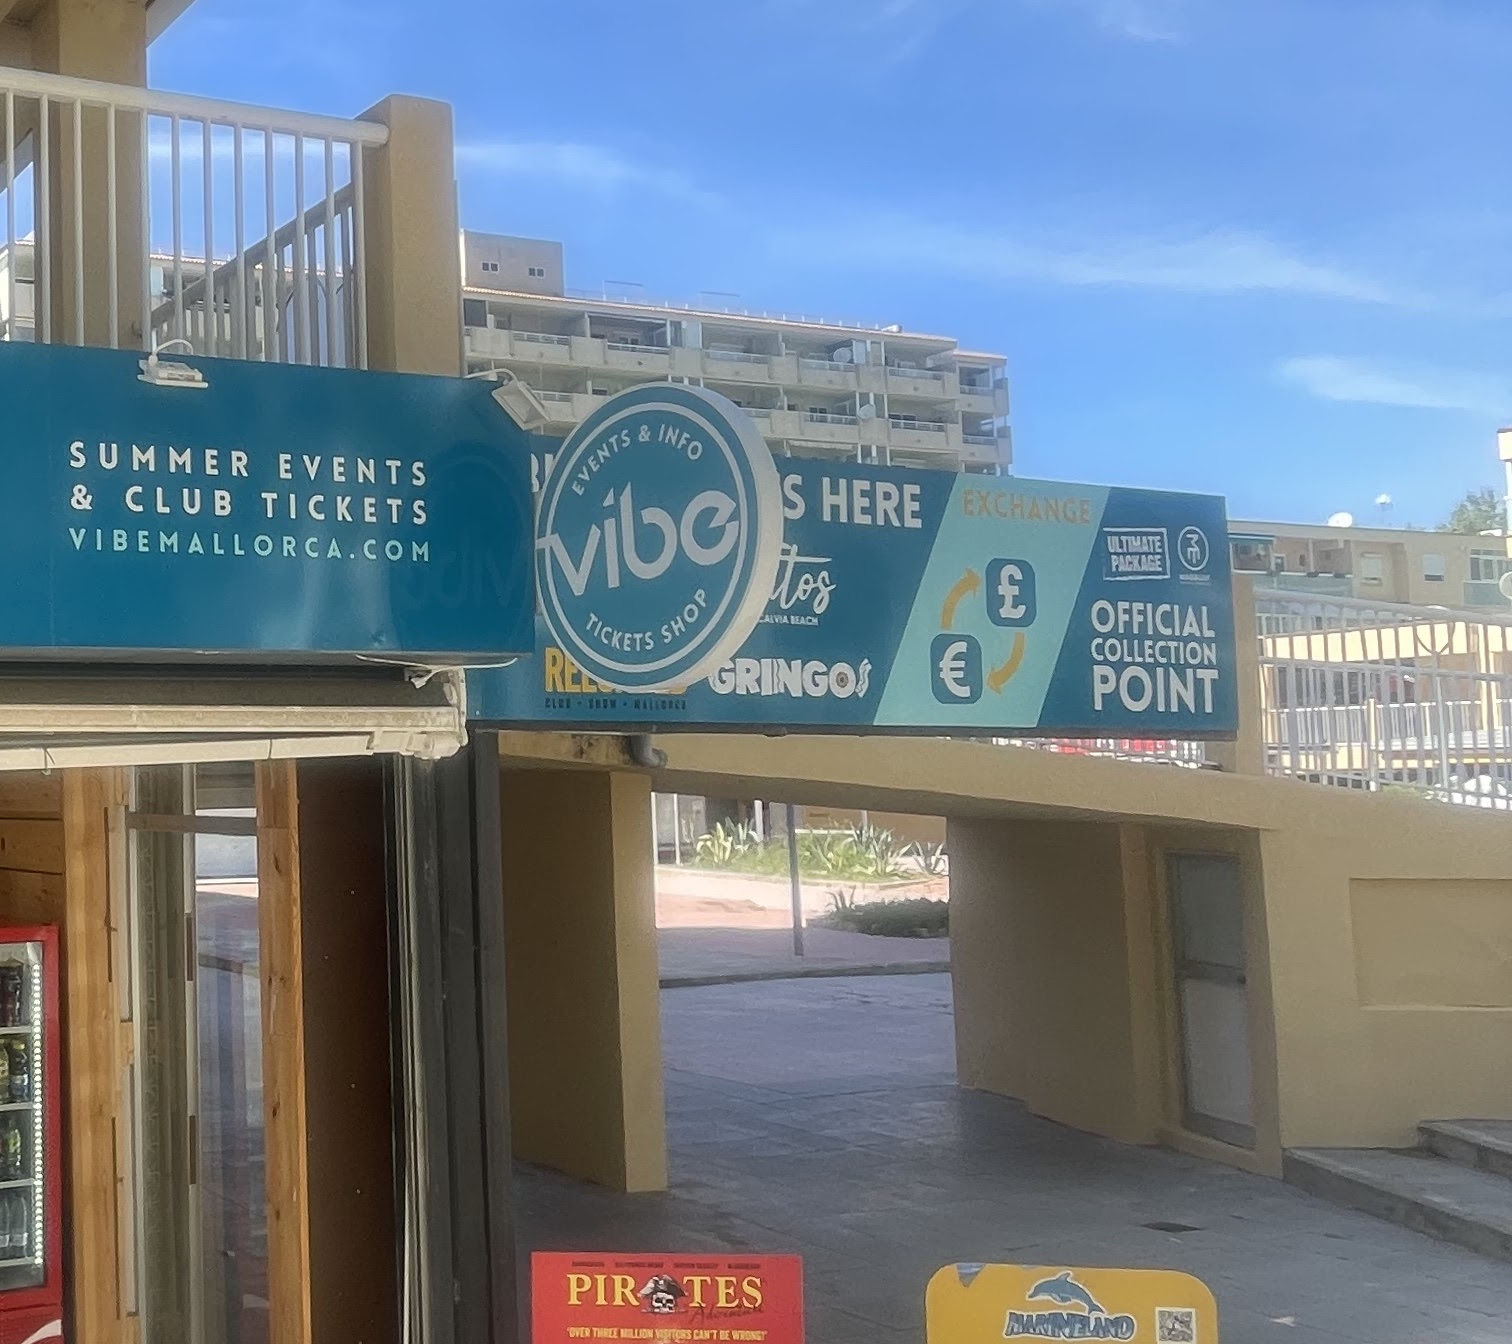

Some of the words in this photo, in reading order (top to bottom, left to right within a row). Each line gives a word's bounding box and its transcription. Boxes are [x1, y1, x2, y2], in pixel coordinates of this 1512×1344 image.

[69, 441, 248, 476] SUMMER
[279, 453, 427, 487] EVENTS
[572, 429, 630, 496] EVENTS
[638, 424, 651, 442] &
[658, 423, 703, 460] INFO
[70, 485, 92, 510] &
[125, 486, 232, 517] CLUB
[261, 492, 428, 525] TICKETS
[822, 477, 923, 529] HERE
[963, 489, 1092, 524] EXCHANGE
[68, 528, 430, 562] VIBEMALLORCA.COM
[535, 482, 740, 597] vibe
[1107, 535, 1163, 553] ULTIMATE
[768, 543, 836, 614] tos
[1111, 554, 1163, 572] PACKAGE
[585, 613, 655, 652] TICKETS
[662, 589, 707, 644] SHOP
[790, 615, 819, 626] BEACH
[1091, 600, 1216, 638] OFFICIAL
[1091, 637, 1217, 665] COLLECTION
[588, 697, 617, 709] SHOW
[1093, 664, 1219, 714] POINT
[566, 1273, 764, 1309] PIRTES
[592, 1327, 618, 1338] THREE
[620, 1328, 654, 1339] MILLION
[655, 1328, 692, 1340] VISITORS
[693, 1329, 718, 1340] CAN'T
[720, 1330, 731, 1340] BE
